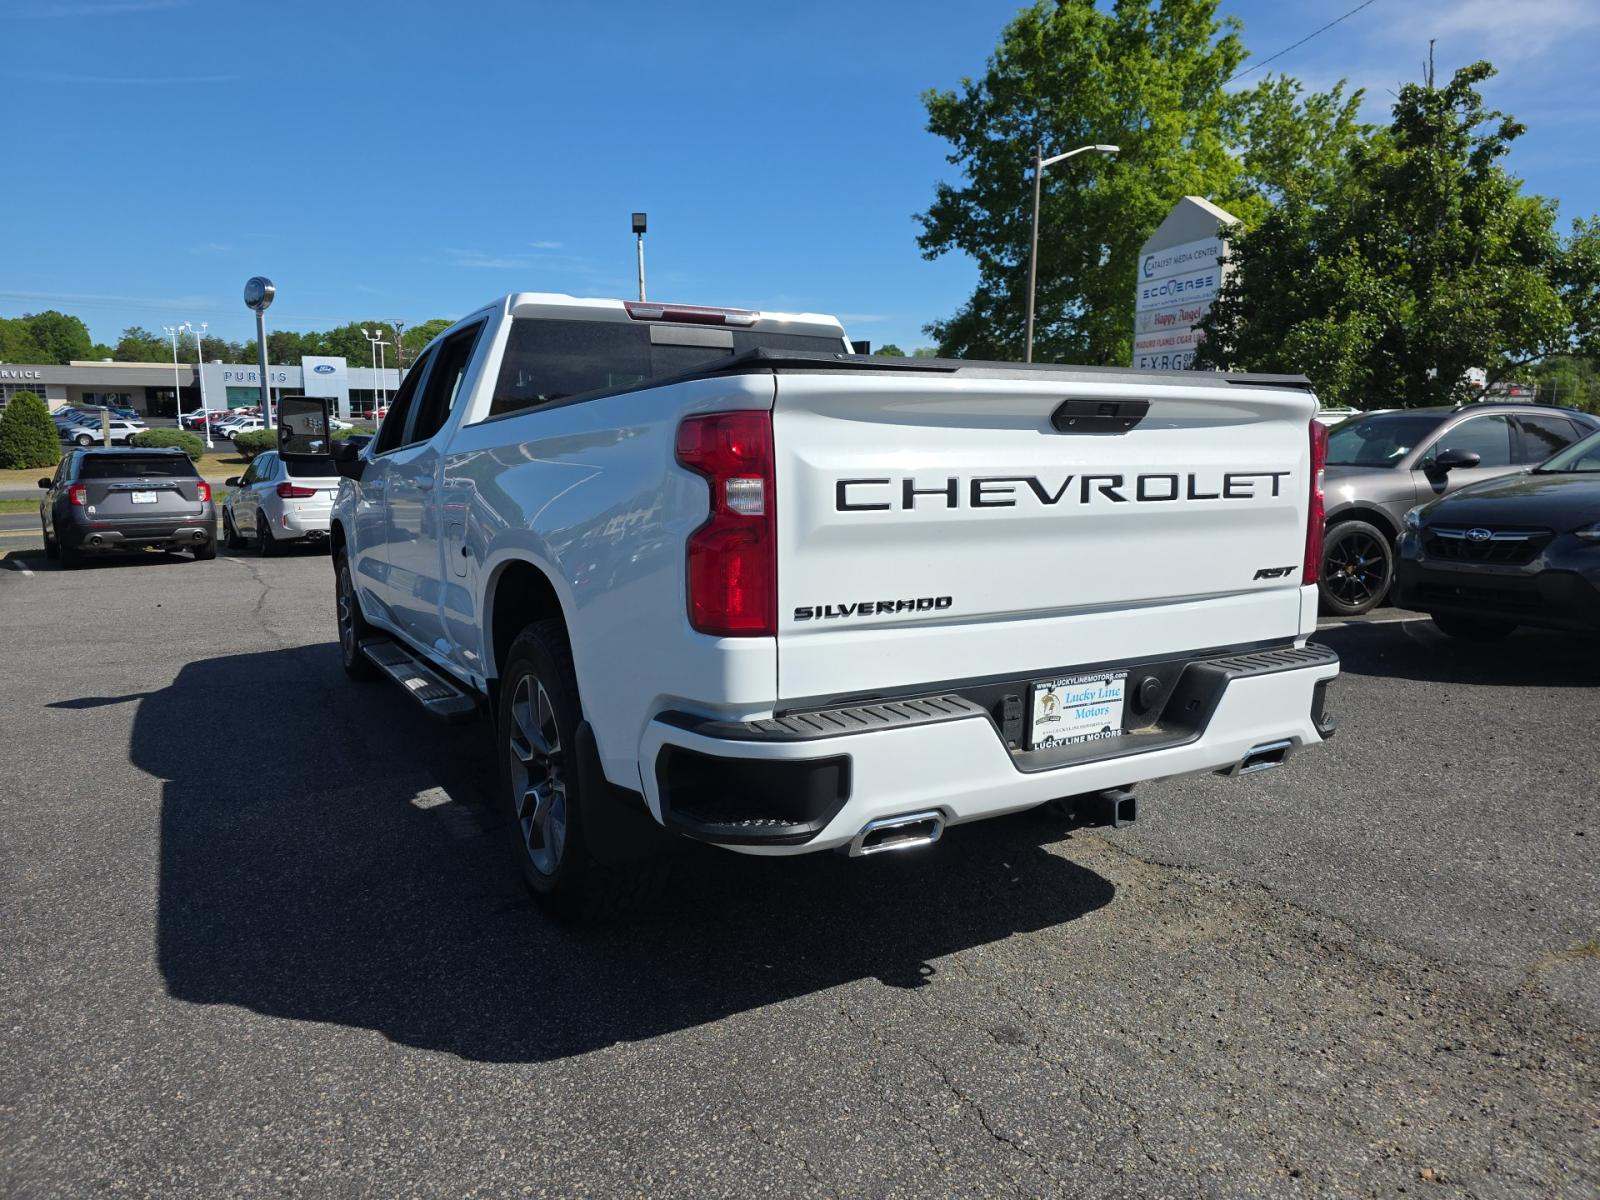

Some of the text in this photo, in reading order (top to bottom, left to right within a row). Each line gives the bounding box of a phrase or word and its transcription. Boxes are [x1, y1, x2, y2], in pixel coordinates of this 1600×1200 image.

[1173, 252, 1192, 265] MEDIA
[1194, 246, 1218, 260] CENTER
[1154, 311, 1177, 326] Happy
[224, 371, 288, 383] PURIS
[835, 471, 1291, 512] CHEVROLET
[1252, 565, 1298, 581] RST
[794, 596, 953, 621] SILVERADO
[1065, 688, 1096, 704] Lucky
[1098, 686, 1121, 700] Line
[1075, 705, 1110, 720] Motors
[1034, 729, 1122, 751] LUCKY LINE MOTORS
